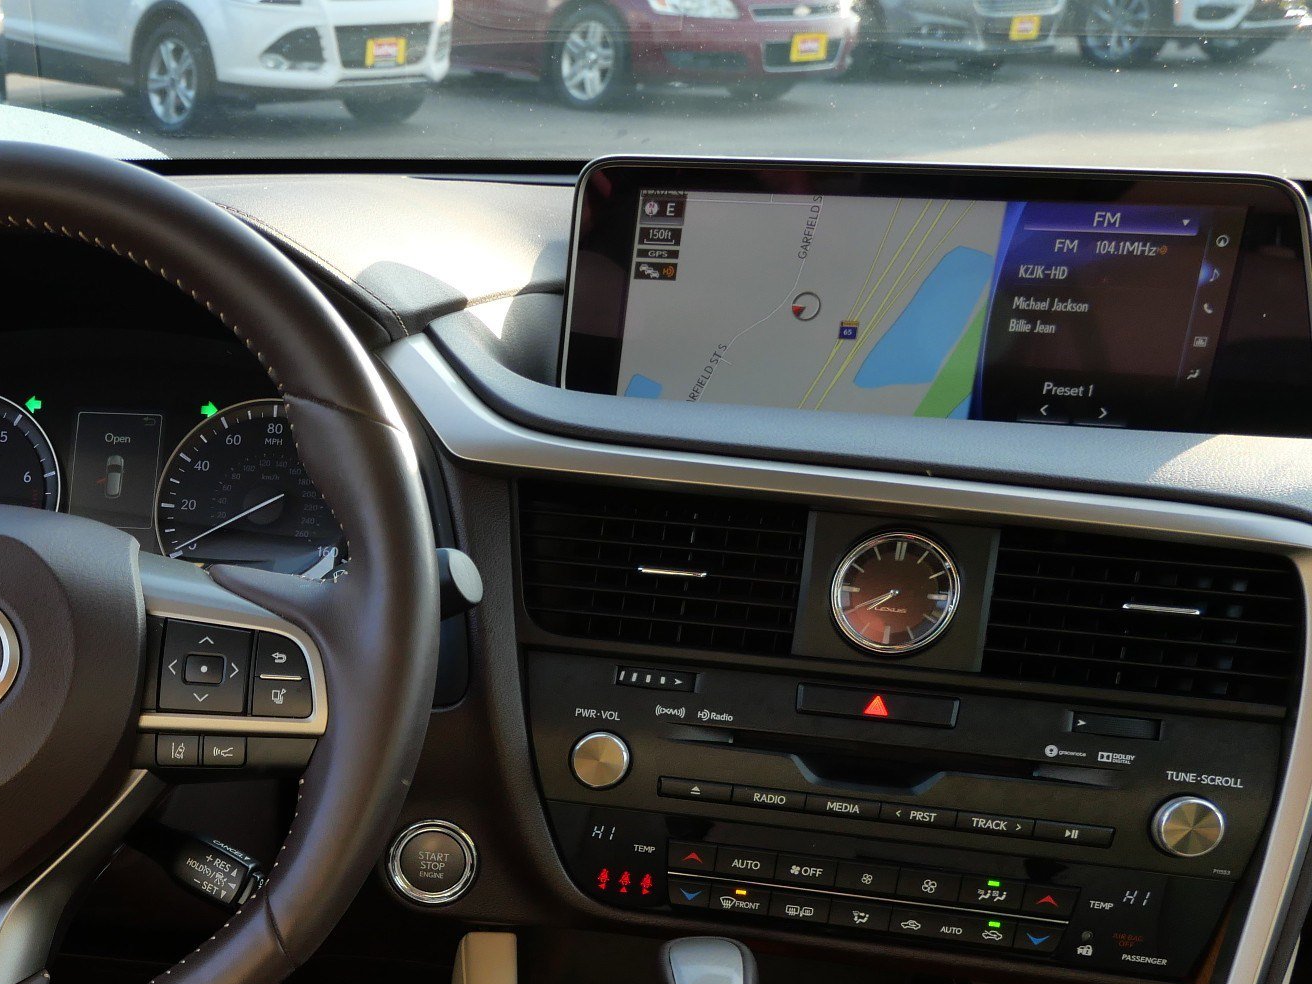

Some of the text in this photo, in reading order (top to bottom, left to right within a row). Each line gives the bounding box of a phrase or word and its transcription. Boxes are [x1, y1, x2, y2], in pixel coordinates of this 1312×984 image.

[666, 203, 676, 216] E
[1093, 211, 1121, 228] FM
[649, 229, 672, 240] 150ft
[798, 203, 821, 259] GARFIELD
[1054, 239, 1078, 253] FM
[1095, 240, 1157, 256] 104.1MHz
[648, 250, 669, 258] GPS
[1018, 265, 1068, 280] KZJK-HD
[1012, 297, 1089, 313] Michael Jackson
[1009, 319, 1056, 334] Billie Jean
[1042, 382, 1094, 397] Preset 1
[267, 423, 283, 434] 80
[0, 431, 8, 443] 5
[105, 432, 131, 445] Open
[225, 434, 242, 446] 60
[264, 438, 283, 446] MPH
[194, 460, 210, 471] 40
[23, 471, 32, 483] 6
[180, 500, 197, 511] 20
[874, 606, 908, 614] LEXUS
[710, 712, 734, 722] Radio
[1112, 753, 1136, 761] DOLBY
[753, 792, 786, 806] RADIO
[826, 801, 860, 815] MEDIA
[909, 810, 937, 823] PRST
[971, 817, 1008, 831] TRACK
[633, 844, 656, 854] TEMP
[418, 851, 450, 862] START
[186, 857, 204, 874] HOLD
[213, 857, 232, 872] RES
[420, 861, 445, 871] STOP
[731, 858, 761, 871] AUTO
[419, 871, 445, 879] ENGINE
[801, 866, 824, 878] OFF
[201, 881, 219, 895] SET
[735, 900, 760, 911] FRONT
[1089, 900, 1114, 911] TEMP
[940, 925, 963, 935] AUTO
[1121, 953, 1168, 966] PASSENGER
